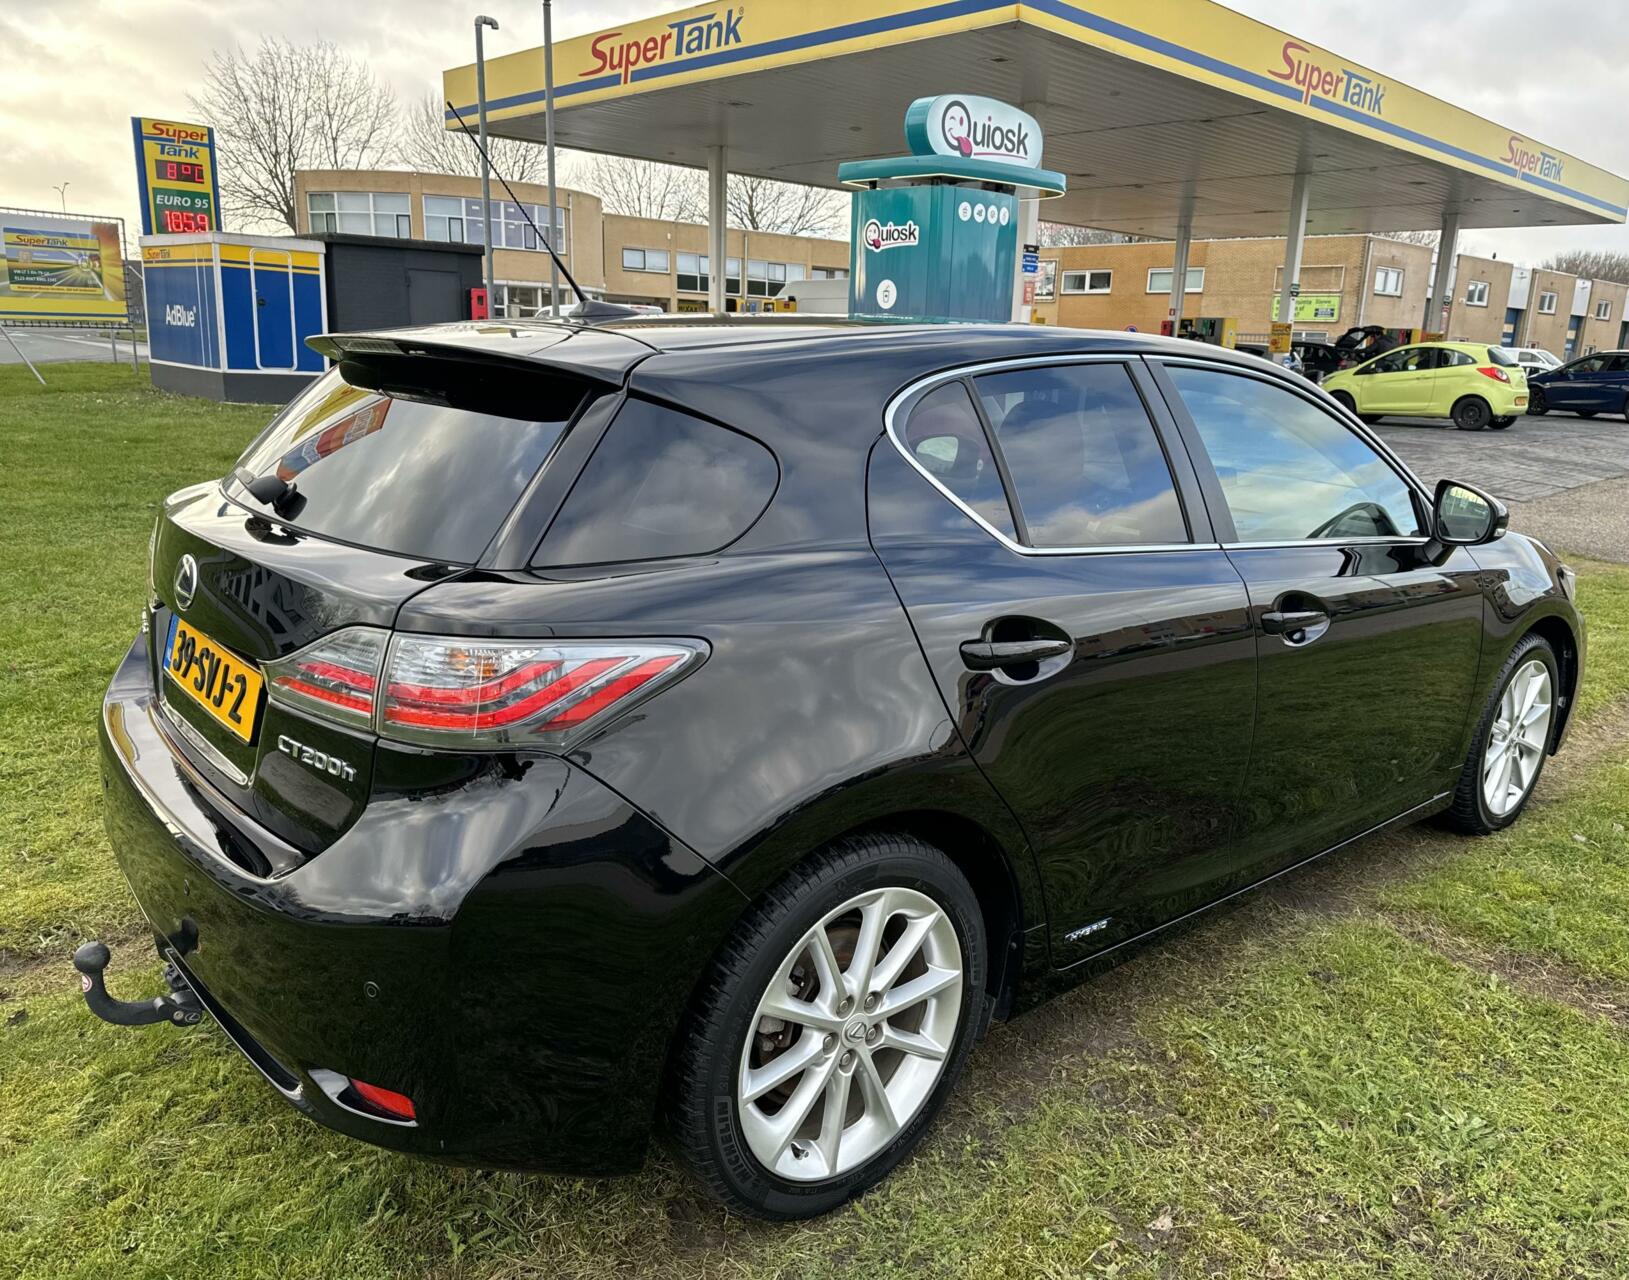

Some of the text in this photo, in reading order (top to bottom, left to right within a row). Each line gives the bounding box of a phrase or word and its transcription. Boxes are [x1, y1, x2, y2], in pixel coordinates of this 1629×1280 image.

[578, 9, 743, 84] SuperTank
[1267, 41, 1385, 115] SuperTank
[144, 122, 207, 144] Super
[154, 142, 200, 160] Tank
[941, 100, 1029, 159] Quiosk
[1500, 136, 1564, 180] SuperTank
[155, 194, 209, 209] EURO 95
[15, 234, 69, 248] SuperTank
[865, 220, 917, 250] Quiosk
[172, 629, 248, 726] 39-SVJ-2
[717, 1099, 752, 1184] MICHELIN
